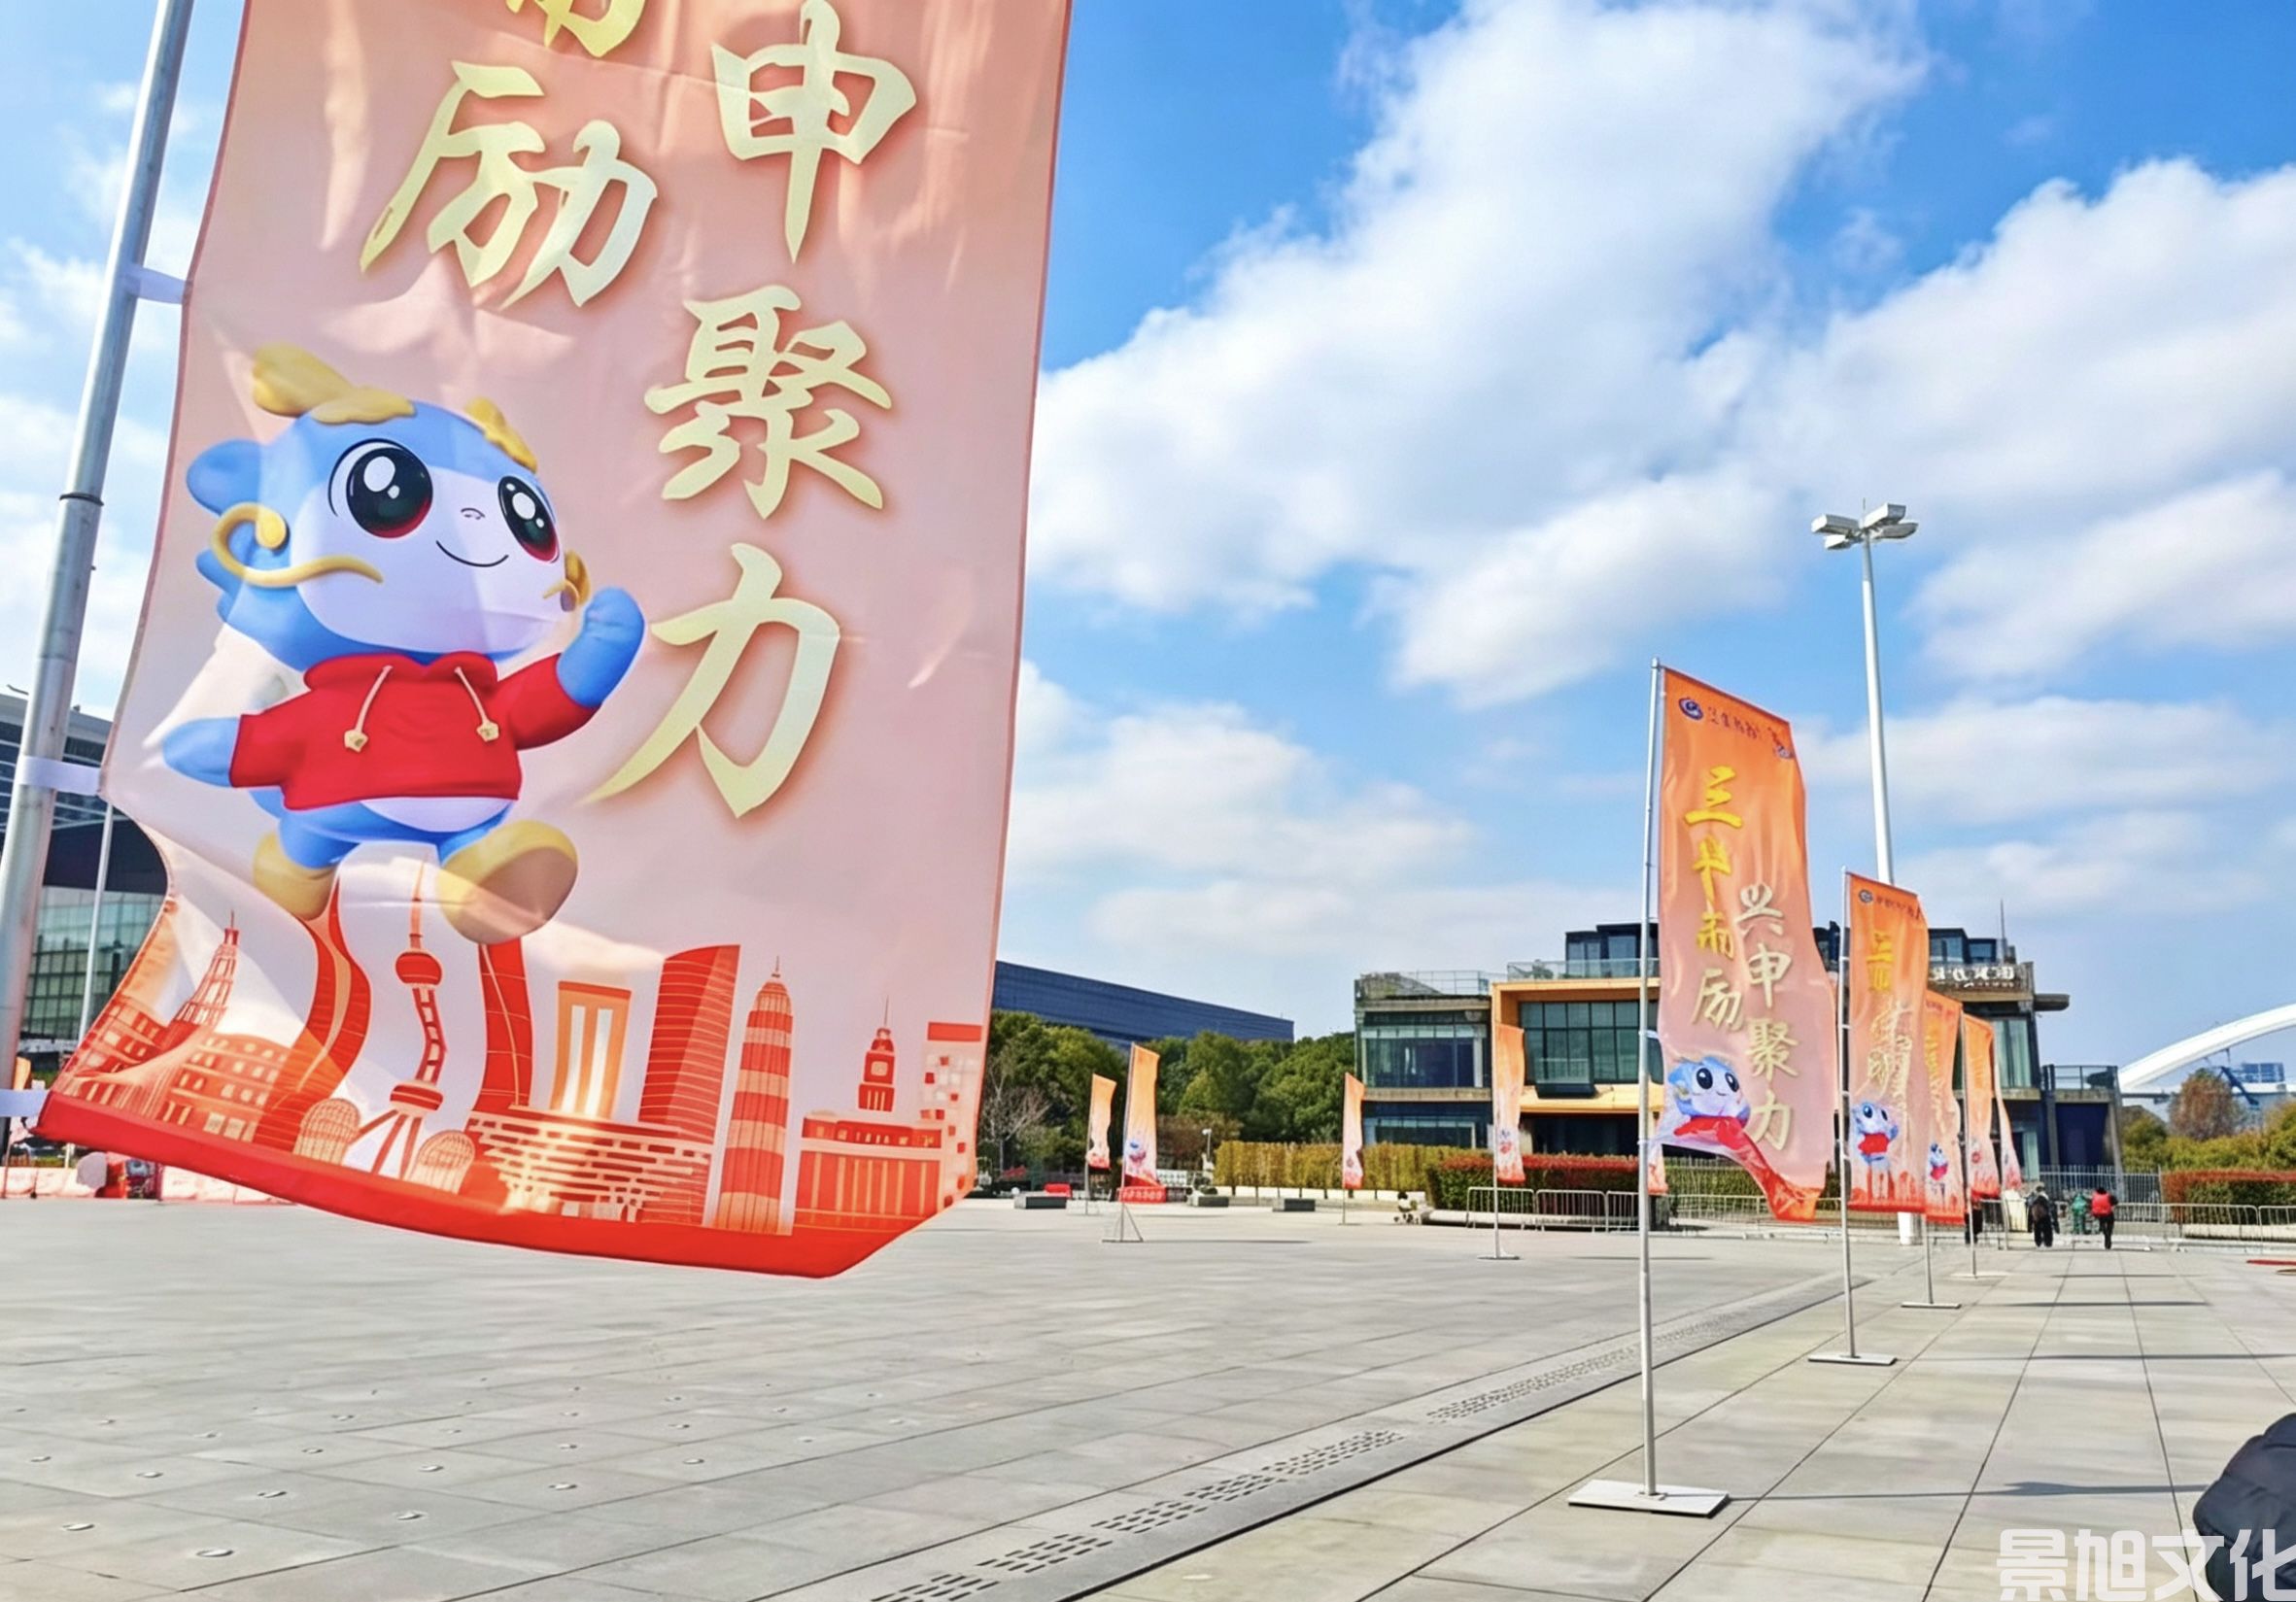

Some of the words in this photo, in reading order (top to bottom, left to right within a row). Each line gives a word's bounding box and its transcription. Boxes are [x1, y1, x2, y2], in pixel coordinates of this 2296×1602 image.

[585, 0, 917, 819] 申聚力
[1732, 882, 1801, 1151] 兴申聚力
